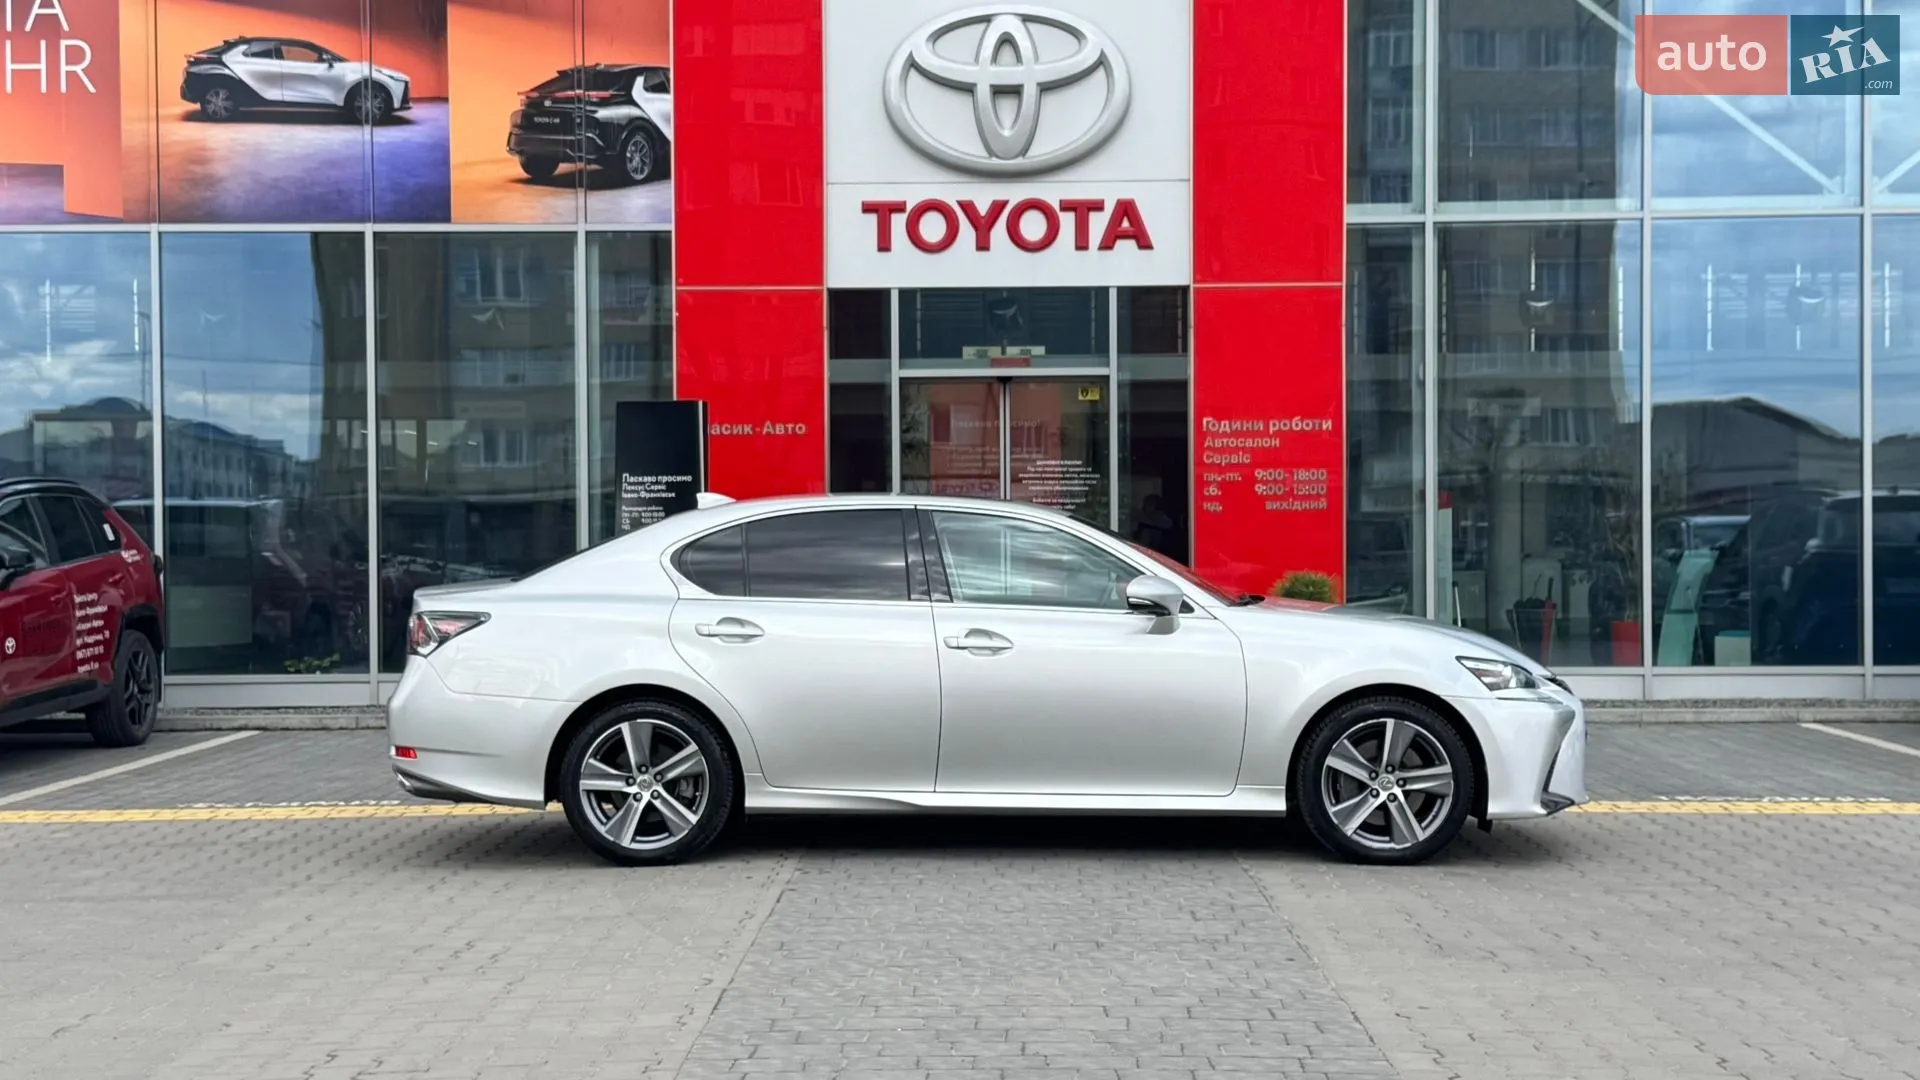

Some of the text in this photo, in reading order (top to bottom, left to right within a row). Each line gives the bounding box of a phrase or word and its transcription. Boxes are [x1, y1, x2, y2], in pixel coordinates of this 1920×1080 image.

[861, 198, 1154, 254] TOYOTA
[1202, 416, 1332, 434] Години роботи
[1204, 436, 1280, 448] Автосалон
[1203, 451, 1251, 466] Сервіс
[658, 475, 693, 484] просимо
[1265, 498, 1327, 511] вихідний
